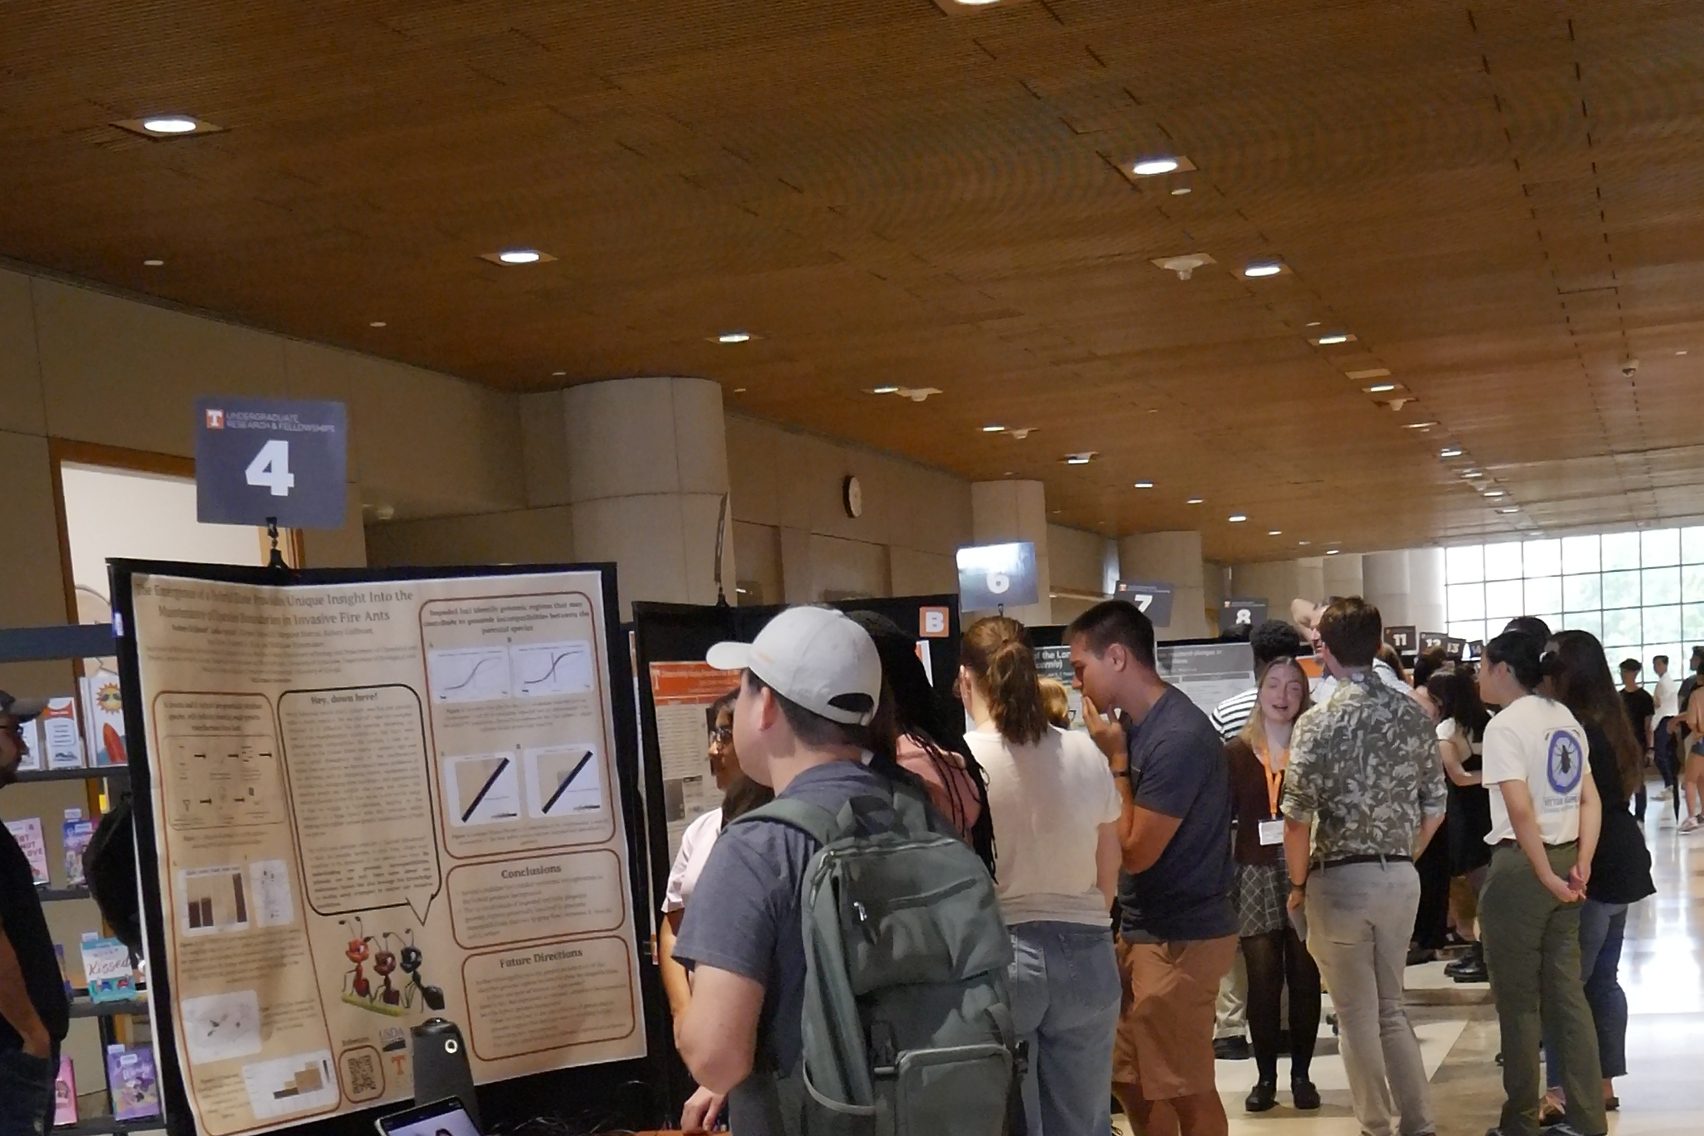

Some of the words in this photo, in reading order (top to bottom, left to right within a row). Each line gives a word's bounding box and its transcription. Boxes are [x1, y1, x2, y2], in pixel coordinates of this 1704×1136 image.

[226, 411, 299, 423] UNDERGRADUATE
[245, 439, 295, 497] 4
[986, 566, 1010, 594] 6
[287, 594, 324, 608] Unique
[327, 591, 366, 607] Insight
[370, 591, 393, 602] Into
[395, 590, 413, 601] the
[1134, 594, 1153, 613] 7
[293, 612, 337, 625] Invasive
[339, 611, 361, 623] Fire
[365, 610, 391, 622] Ants
[925, 611, 944, 633] B
[1236, 608, 1252, 625] 8
[1393, 633, 1408, 646] 11
[1042, 651, 1055, 660] the
[500, 863, 562, 880] Conclusions
[499, 955, 532, 969] Future
[533, 948, 584, 962] Directions
